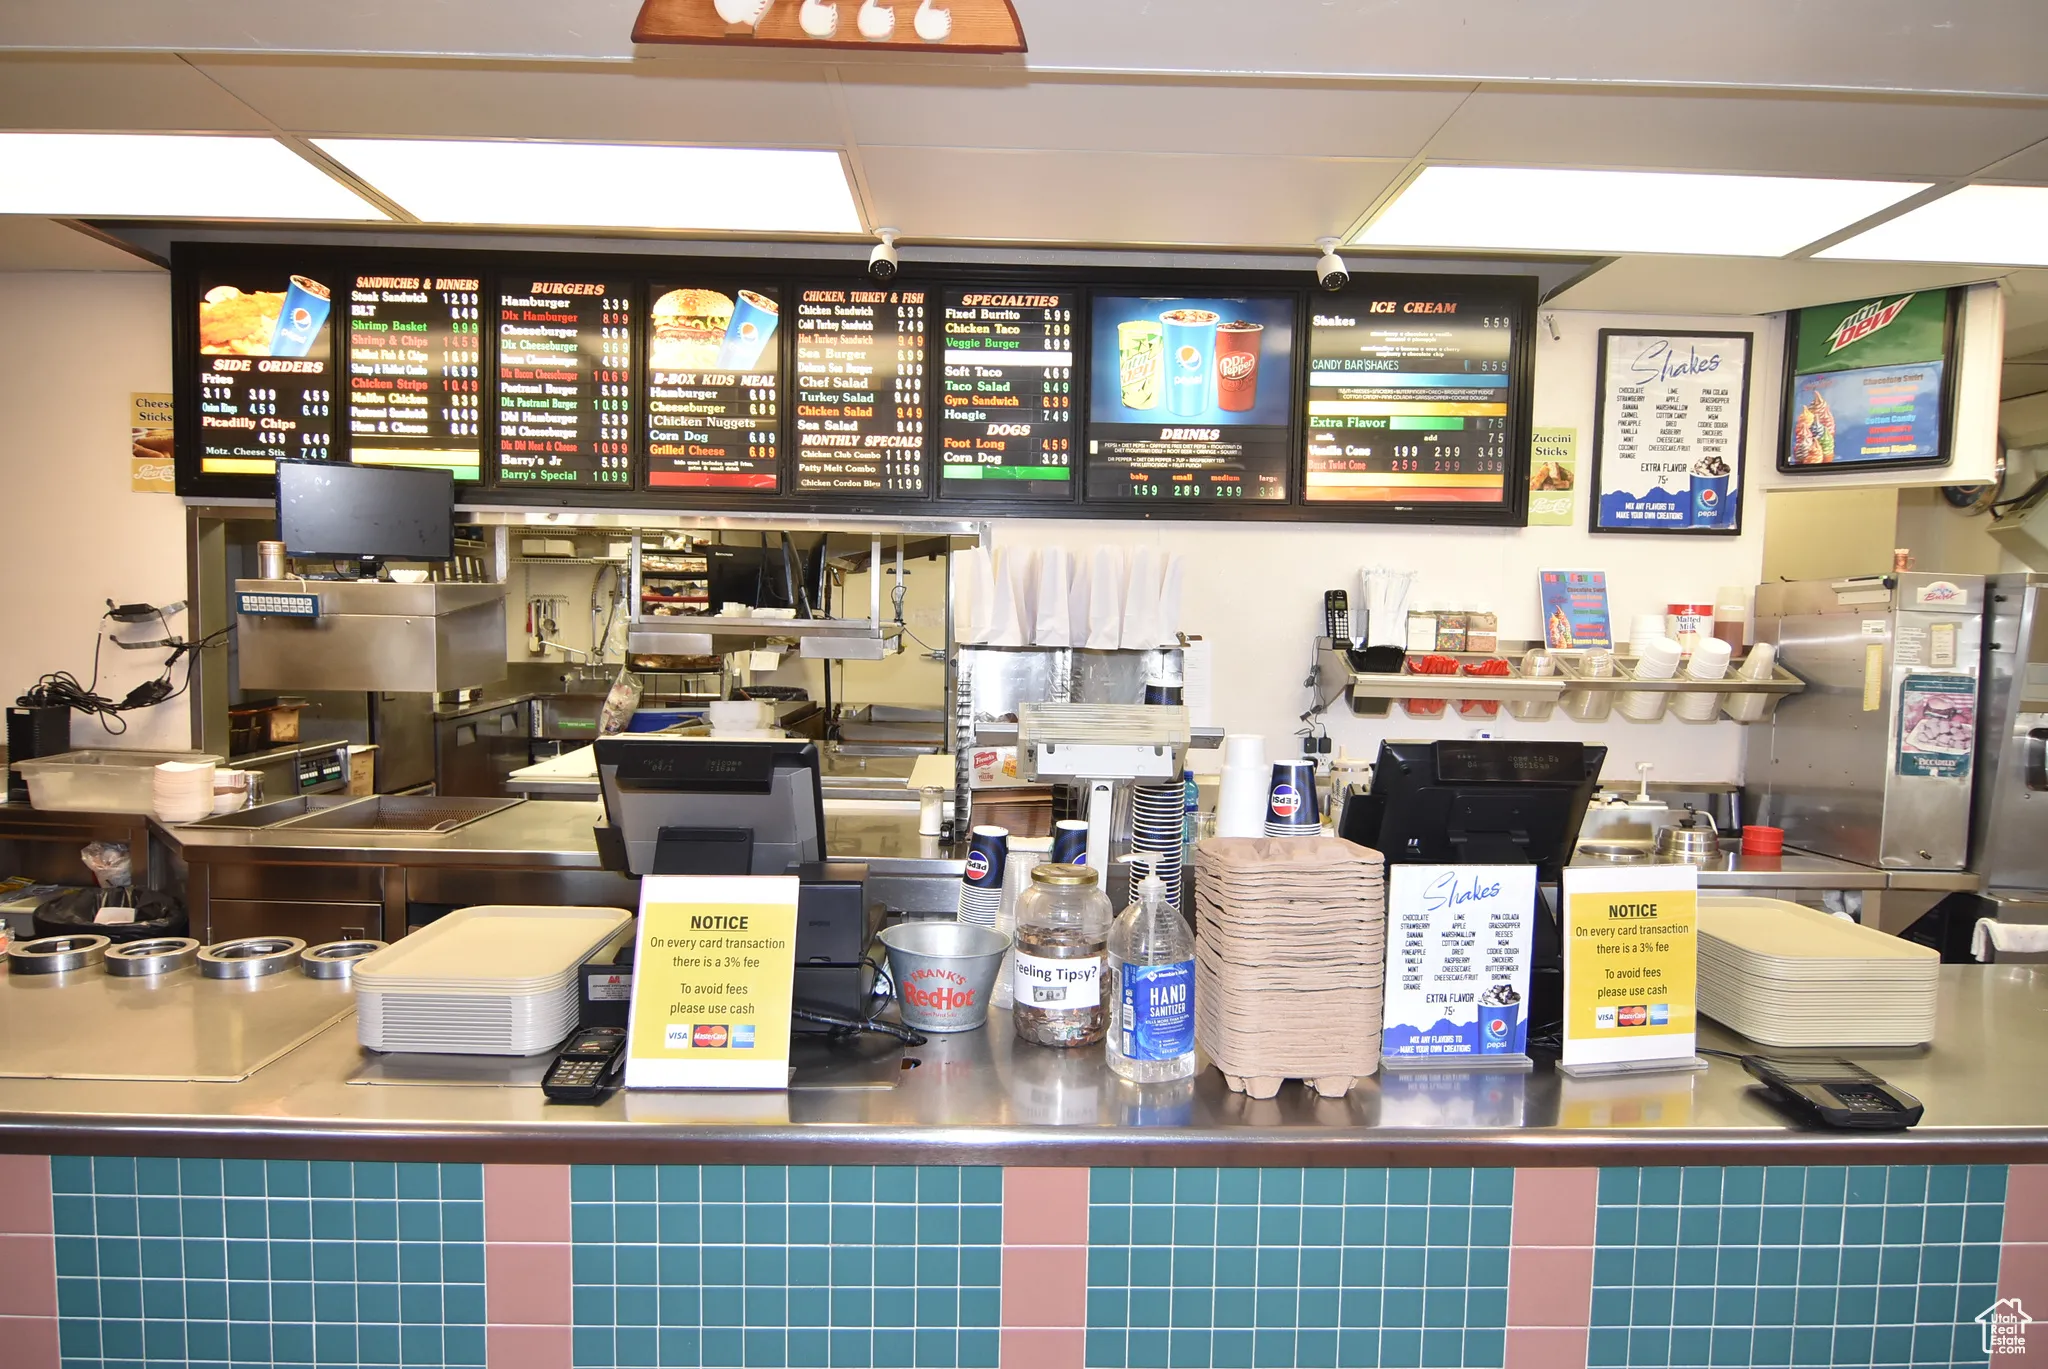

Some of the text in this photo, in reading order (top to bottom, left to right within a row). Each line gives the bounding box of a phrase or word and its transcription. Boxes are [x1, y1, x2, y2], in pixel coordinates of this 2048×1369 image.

[356, 276, 479, 291] SANDWICHES & DINNERS
[531, 282, 605, 295] BURGERS
[502, 296, 570, 309] Hamburger
[803, 291, 924, 304] CHICKEN, TURKEY & FISH
[962, 294, 1058, 307] SPECIALTIES
[352, 306, 376, 316] BLT
[1370, 301, 1457, 314] ICE CREAM
[502, 311, 577, 323] Dlx Hamburger
[1313, 315, 1356, 326] Shakes
[352, 321, 427, 332] Shrimp Basket
[945, 324, 1020, 335] Chicken Taco
[946, 338, 1020, 350] Veggie Burger
[213, 359, 324, 373] SIDE ORDERS
[1232, 356, 1245, 366] Dr
[1312, 360, 1342, 370] CANDY
[1631, 340, 1722, 385] Shakes
[1220, 358, 1253, 377] Pepper
[202, 374, 234, 384] Fries
[352, 378, 428, 390] Chicken Strips
[653, 373, 775, 386] B-BOX KIDS MEAL
[945, 381, 1010, 392] Taco Salad
[800, 392, 874, 404] Turkey Salad
[944, 396, 1019, 408] Gyro Sandwich
[139, 412, 172, 421] Sticks
[798, 406, 872, 418] Chicken Salad
[944, 410, 987, 422] Hoagie
[202, 417, 296, 430] Picadilly Chips
[654, 416, 756, 429] Chicken Nuggets
[1310, 417, 1386, 428] Extra Flavor
[987, 424, 1030, 436] DOGS
[1160, 428, 1220, 440] DRINKS
[650, 430, 708, 443] Corn Dog
[802, 435, 922, 448] MONTHLY SPECIALS
[1532, 433, 1572, 444] Zuccini
[944, 438, 1005, 451] Foot Long
[206, 447, 285, 457] Motz. Cheese Stix
[650, 445, 724, 457] Grilled Cheese
[1535, 446, 1568, 456] Sticks
[845, 465, 876, 474] Combo
[1641, 463, 1687, 472] EXTRA FLAVOR
[502, 469, 577, 482] Barry's Special
[1130, 473, 1148, 481] baby
[1423, 871, 1502, 911] Shakes
[1609, 904, 1657, 918] NOTICE
[690, 916, 748, 930] NOTICE
[1576, 923, 1689, 938] On every card transaction
[650, 936, 785, 950] On every card transaction
[1597, 942, 1669, 954] there is a 3% fee
[673, 956, 760, 968] there is a 3% fee
[910, 969, 966, 985] FRANK'S
[1056, 966, 1097, 982] Tipsy?
[1605, 967, 1661, 979] To avoid fees
[680, 983, 748, 995] To avoid fees
[903, 980, 976, 1010] RedHot
[1150, 984, 1186, 1006] HAND
[1598, 986, 1626, 999] please
[1647, 984, 1667, 995] cash
[1426, 993, 1474, 1003] EXTRA FLAVOR
[670, 1003, 755, 1015] please use cash
[1150, 1003, 1186, 1017] SANITIZER
[668, 1032, 688, 1040] VISA
[1487, 1041, 1506, 1049] pepsi
